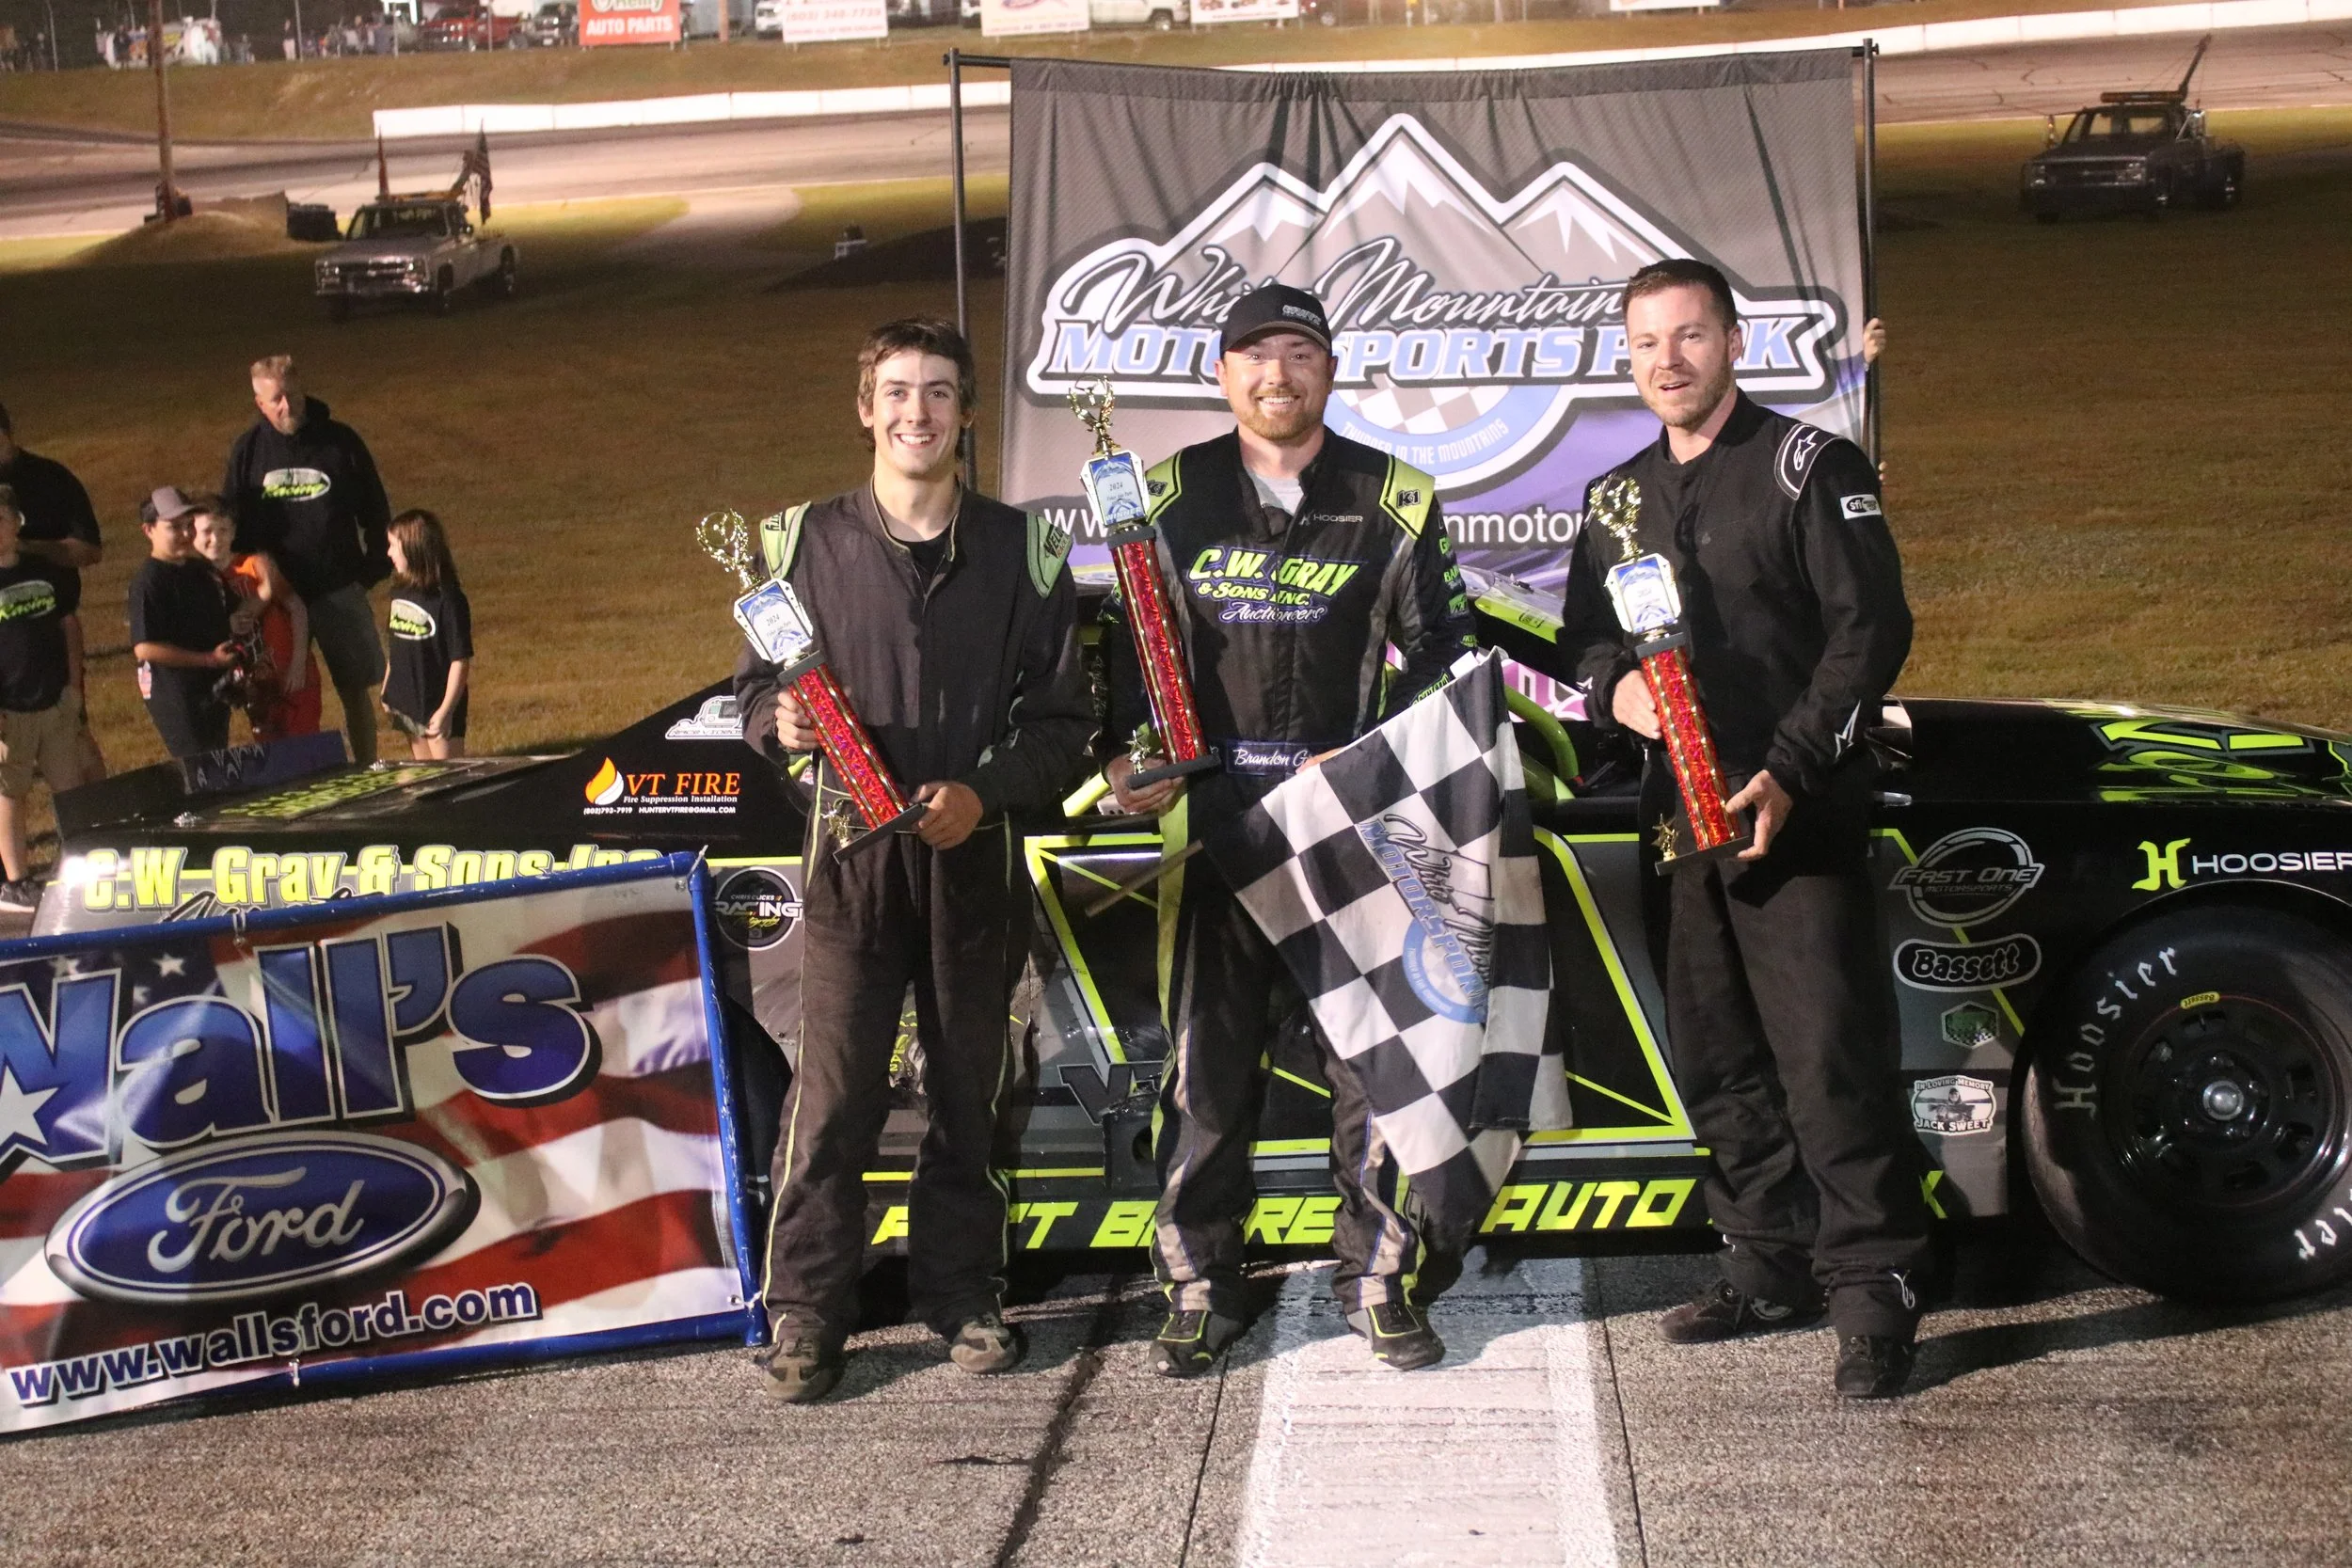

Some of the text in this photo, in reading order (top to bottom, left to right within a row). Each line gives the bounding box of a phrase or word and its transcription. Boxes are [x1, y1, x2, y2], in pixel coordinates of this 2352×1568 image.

[586, 15, 674, 35] AUTO PARTS
[1060, 237, 1628, 341] Whi Mountain
[1044, 316, 1806, 380] MOTPORTS PK
[1395, 444, 1407, 462] IN
[1411, 446, 1435, 464] THE
[1438, 418, 1510, 463] MOUNTAINS
[1313, 514, 1363, 524] HOOSIER
[1188, 548, 1359, 597] C.W. GRAY
[1198, 581, 1212, 596] &
[1221, 601, 1326, 622] Auctioneers
[1233, 747, 1289, 767] Brandon
[626, 773, 740, 796] VT FIRE
[641, 796, 689, 804] Suppression
[691, 795, 738, 803] Installation
[358, 845, 400, 895] &
[1899, 868, 1973, 884] FAST
[1925, 884, 2014, 893] MOTORSPORTS
[716, 901, 803, 917] RACING
[1912, 942, 2021, 983] Bassett
[2053, 946, 2179, 1120] Hoosier
[1916, 1077, 1991, 1090] IN LOVING MEMORY
[1916, 1117, 1990, 1132] JACK SWEET
[1478, 1179, 1697, 1233] AUTO
[147, 1164, 367, 1274] Ford
[9, 1282, 541, 1405] www.wallsford.com
